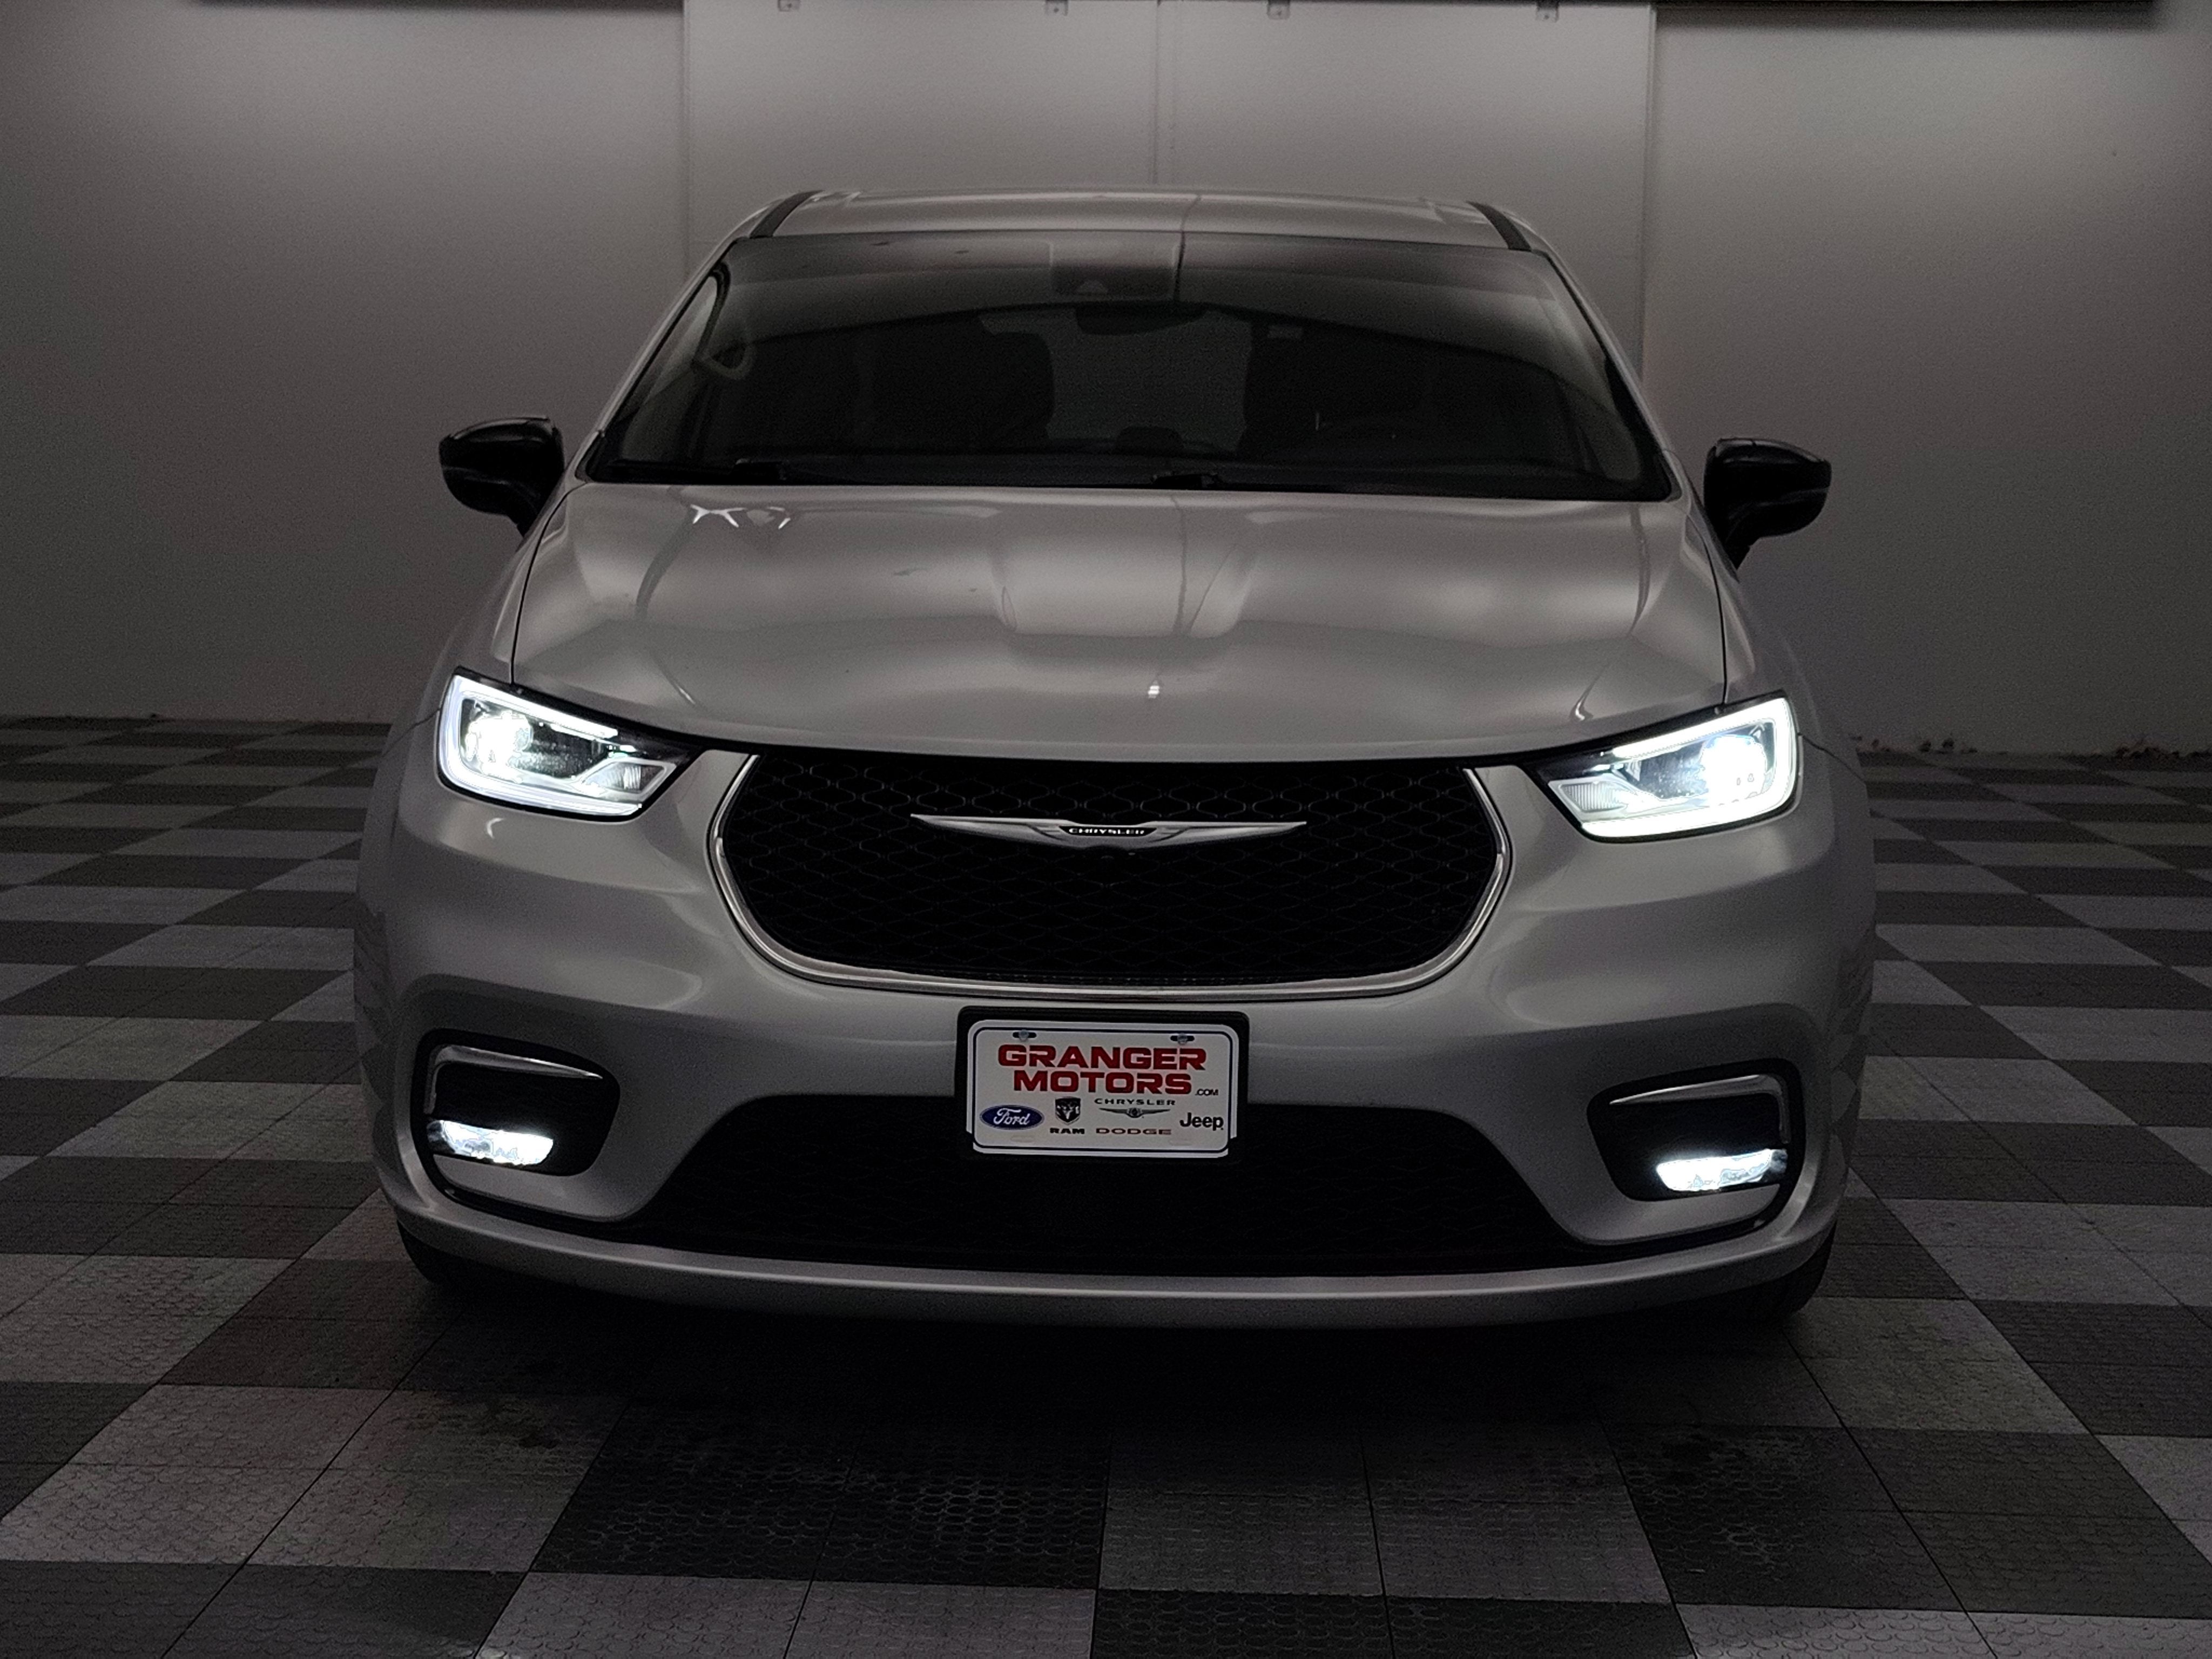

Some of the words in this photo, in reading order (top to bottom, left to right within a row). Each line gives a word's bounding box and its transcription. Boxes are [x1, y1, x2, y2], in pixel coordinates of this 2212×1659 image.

[998, 1044, 1206, 1070] GRANGER
[1014, 1070, 1192, 1095] MOTORS
[1094, 1098, 1176, 1106] CHRYSLER
[993, 1108, 1030, 1126] Ford
[1179, 1112, 1224, 1131] Jeep
